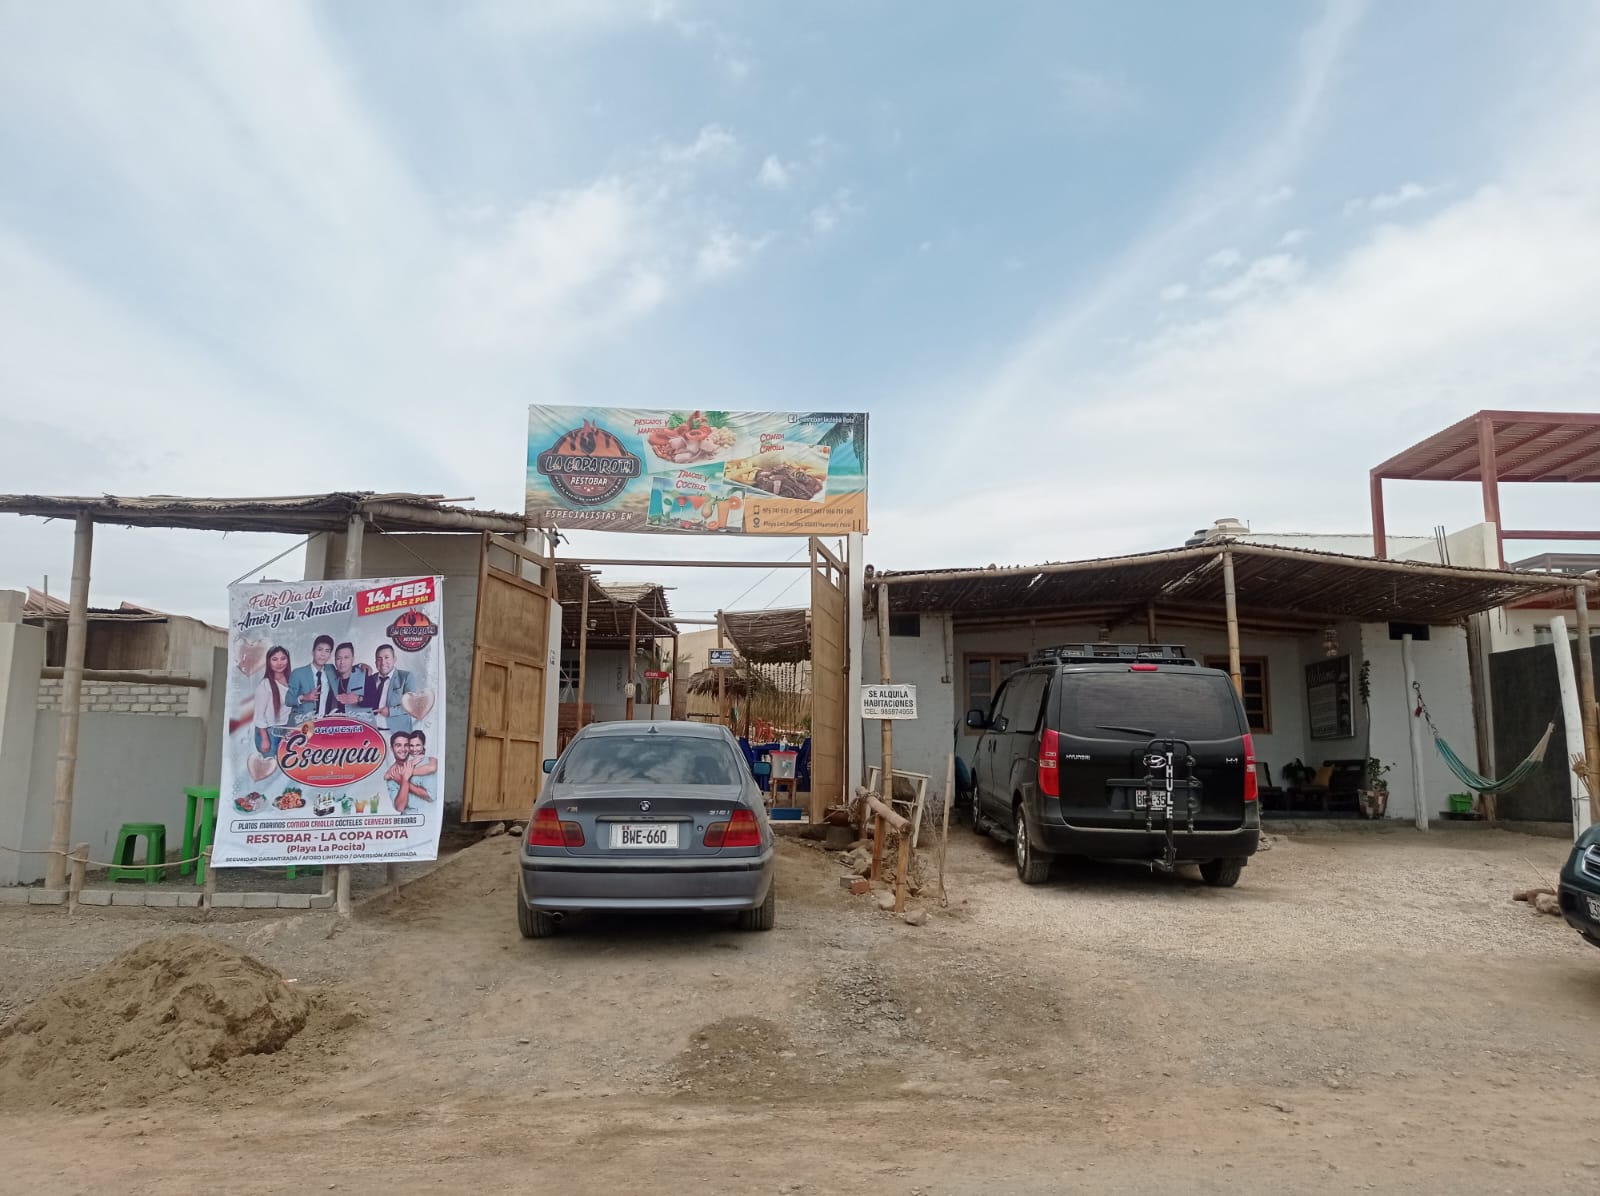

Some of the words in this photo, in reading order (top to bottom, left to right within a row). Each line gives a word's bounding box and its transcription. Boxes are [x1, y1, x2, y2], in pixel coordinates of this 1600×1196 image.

[546, 456, 562, 472] LA
[564, 457, 597, 473] COPA
[600, 459, 633, 474] ROTA
[571, 476, 609, 486] RESTOBAR
[545, 509, 617, 520] ESPECIALISTAS
[621, 512, 633, 520] EN
[249, 593, 278, 611] Feliz
[305, 585, 322, 600] del
[365, 602, 391, 613] DESDE
[392, 600, 408, 608] LAS
[415, 595, 429, 604] PM
[238, 612, 270, 631] Amor
[271, 613, 281, 628] y
[284, 607, 295, 621] la
[299, 596, 352, 620] Amistad
[868, 690, 878, 698] SE
[879, 690, 909, 699] ALQUILA
[863, 699, 914, 708] HABITACIONES
[314, 725, 363, 735] ORQUESTA
[238, 822, 257, 830] PLATOS
[260, 821, 285, 829] MARINOS
[287, 820, 309, 829] COMIDA
[311, 819, 334, 828] CRIOLLA
[364, 817, 392, 826] CERVEZAS
[393, 816, 417, 825] BEBIDAS
[246, 833, 312, 844] RESTOBAR
[321, 832, 336, 841] LA
[340, 830, 373, 841] COPA
[376, 829, 409, 840] ROTA
[622, 830, 668, 845] BWE-660
[286, 844, 316, 854] (Playa
[318, 844, 329, 852] La
[331, 842, 365, 852] Pocita)
